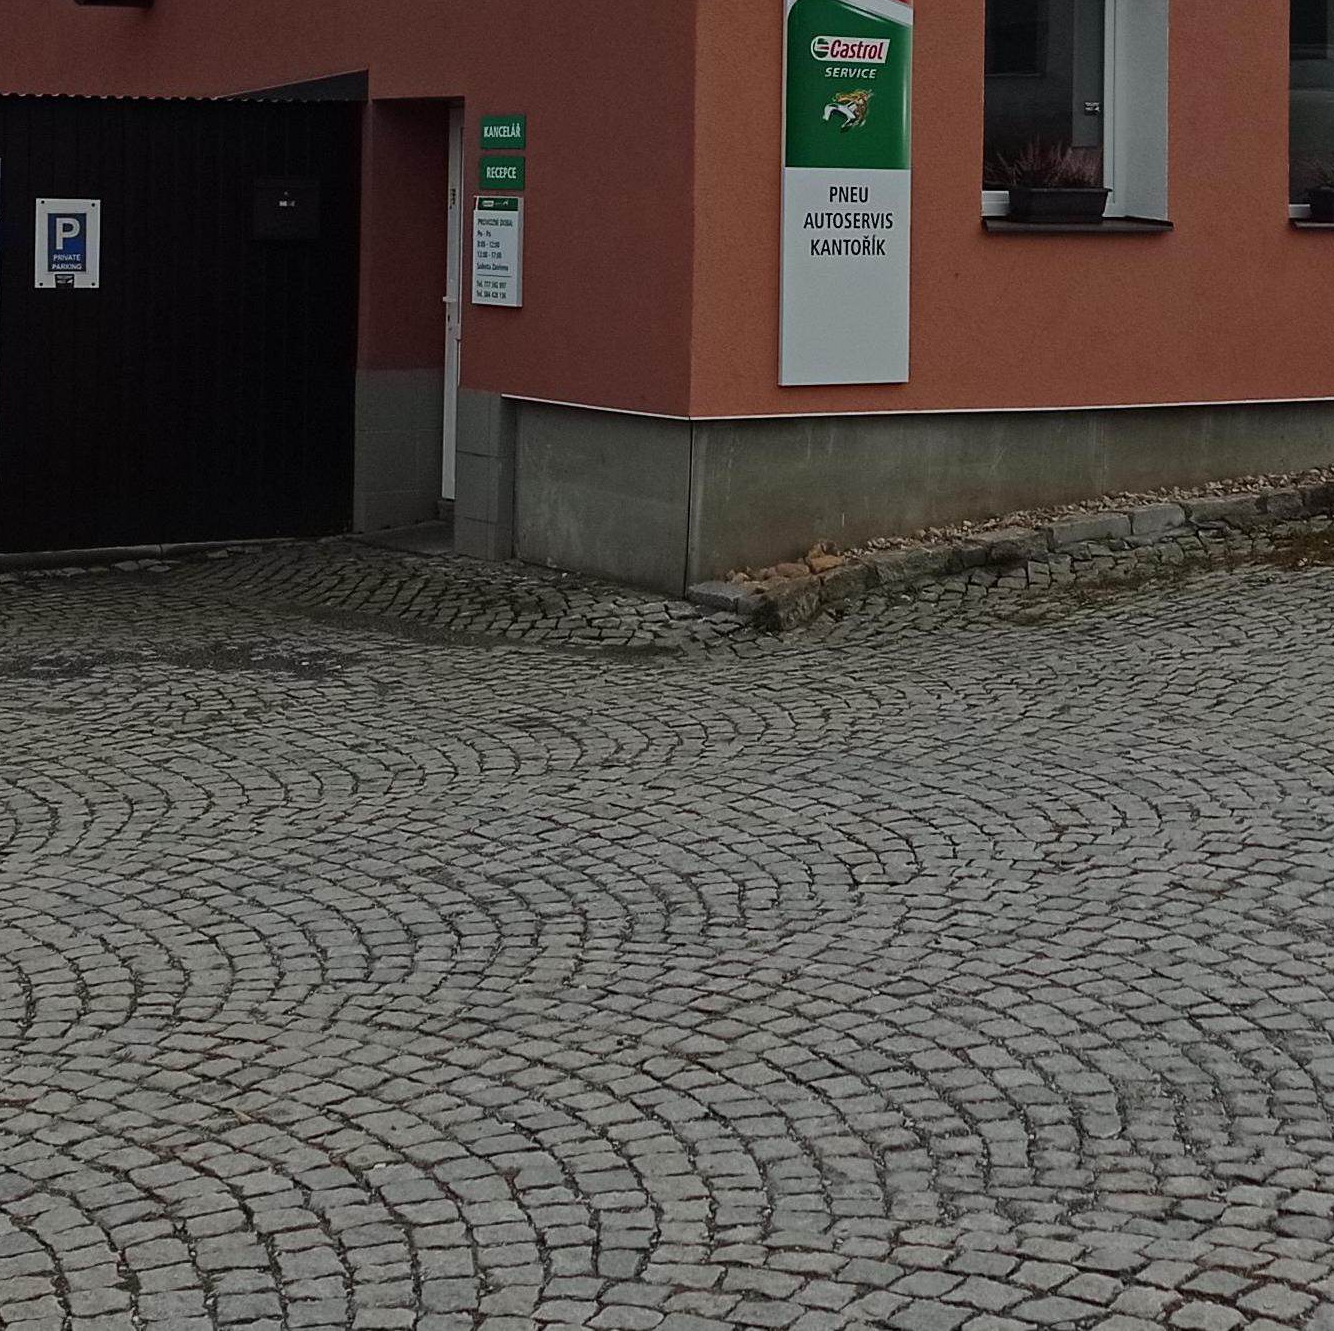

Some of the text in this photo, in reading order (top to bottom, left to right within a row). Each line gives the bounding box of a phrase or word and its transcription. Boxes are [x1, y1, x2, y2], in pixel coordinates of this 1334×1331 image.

[830, 39, 884, 60] Castrol
[824, 66, 878, 80] SERVICE
[483, 122, 521, 138] KANCELÁŘ
[486, 166, 517, 179] RECEPCE
[829, 186, 869, 203] PNEU
[803, 212, 894, 230] AUTOSERVIS
[56, 217, 81, 251] P
[810, 234, 887, 257] KANTOŘÍK
[53, 253, 81, 262] PRIVATE
